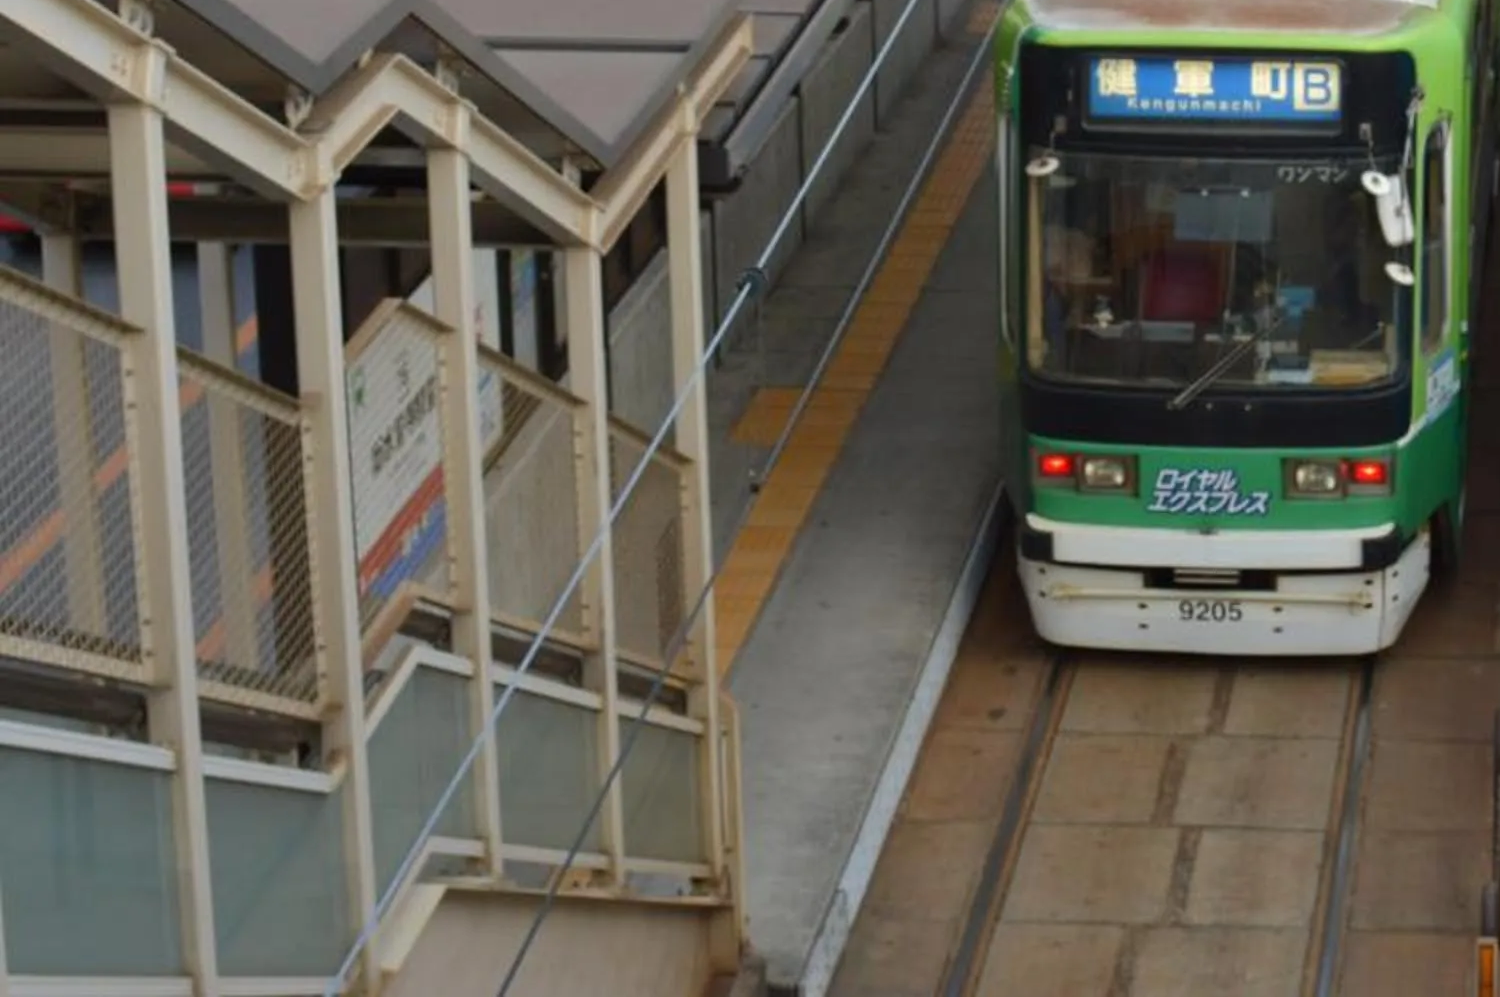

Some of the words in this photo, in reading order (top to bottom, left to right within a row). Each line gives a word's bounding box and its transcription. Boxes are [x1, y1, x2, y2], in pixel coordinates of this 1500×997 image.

[1303, 68, 1331, 106] B
[1127, 97, 1261, 113] Kengunmachi
[1278, 165, 1349, 182] ワンマン
[1155, 468, 1238, 491] ロイヤル
[1148, 490, 1271, 515] エクスプレス
[1179, 600, 1242, 622] 9205
